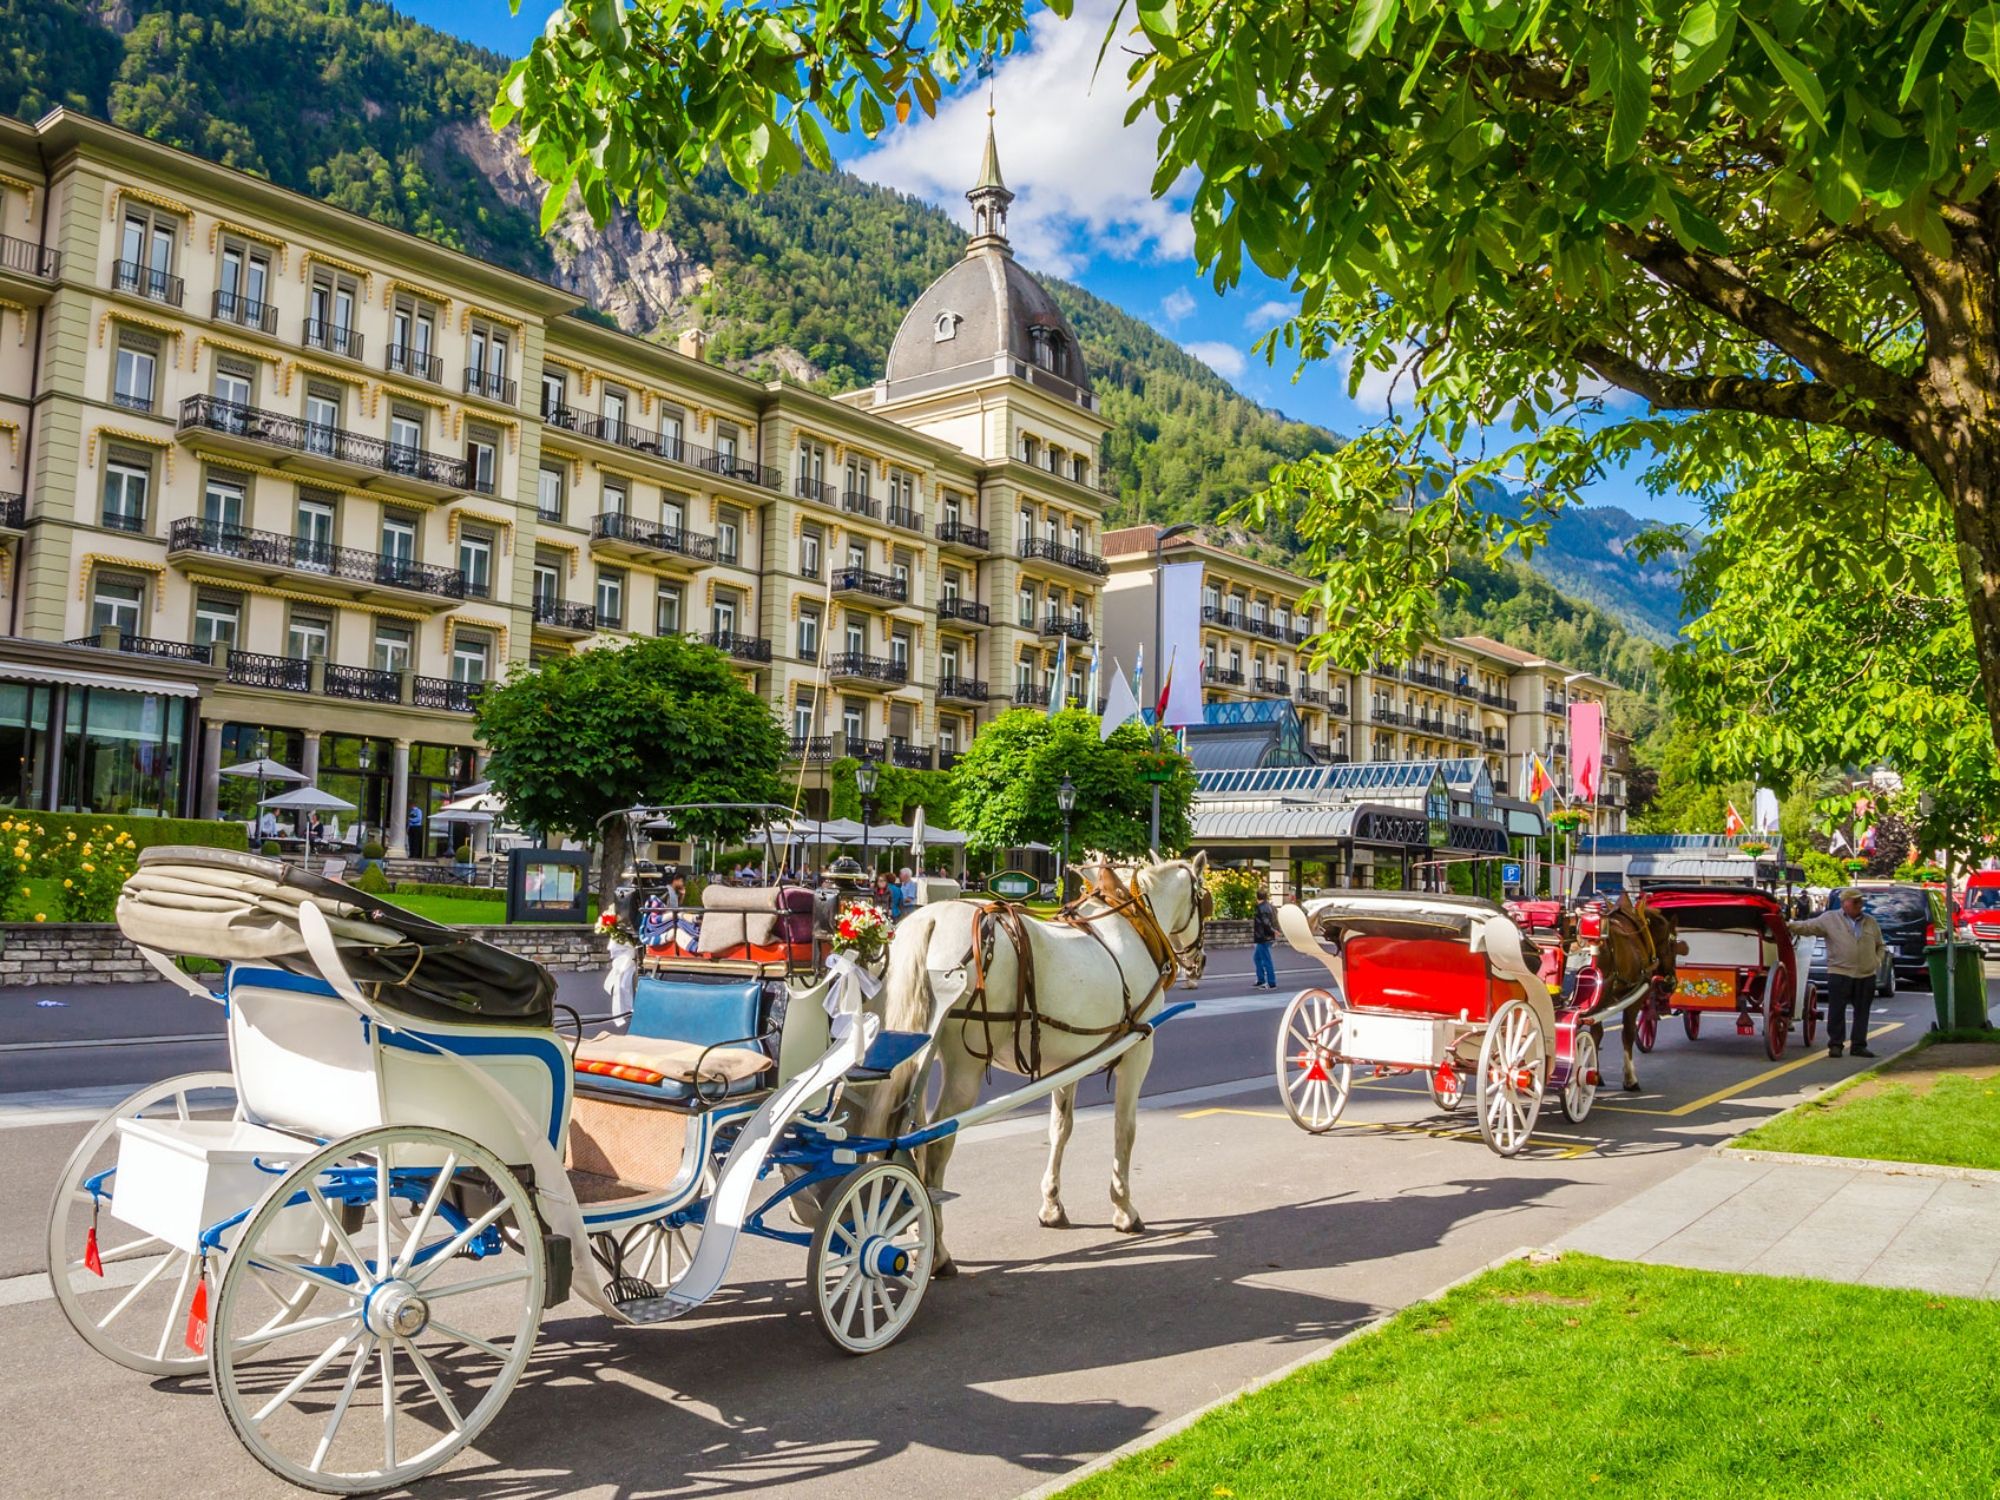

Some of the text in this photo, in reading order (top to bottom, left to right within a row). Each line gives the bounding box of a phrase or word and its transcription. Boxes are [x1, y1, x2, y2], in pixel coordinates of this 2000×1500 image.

[1507, 868, 1515, 878] P
[1444, 1079, 1456, 1091] 76
[195, 1319, 207, 1349] 80
